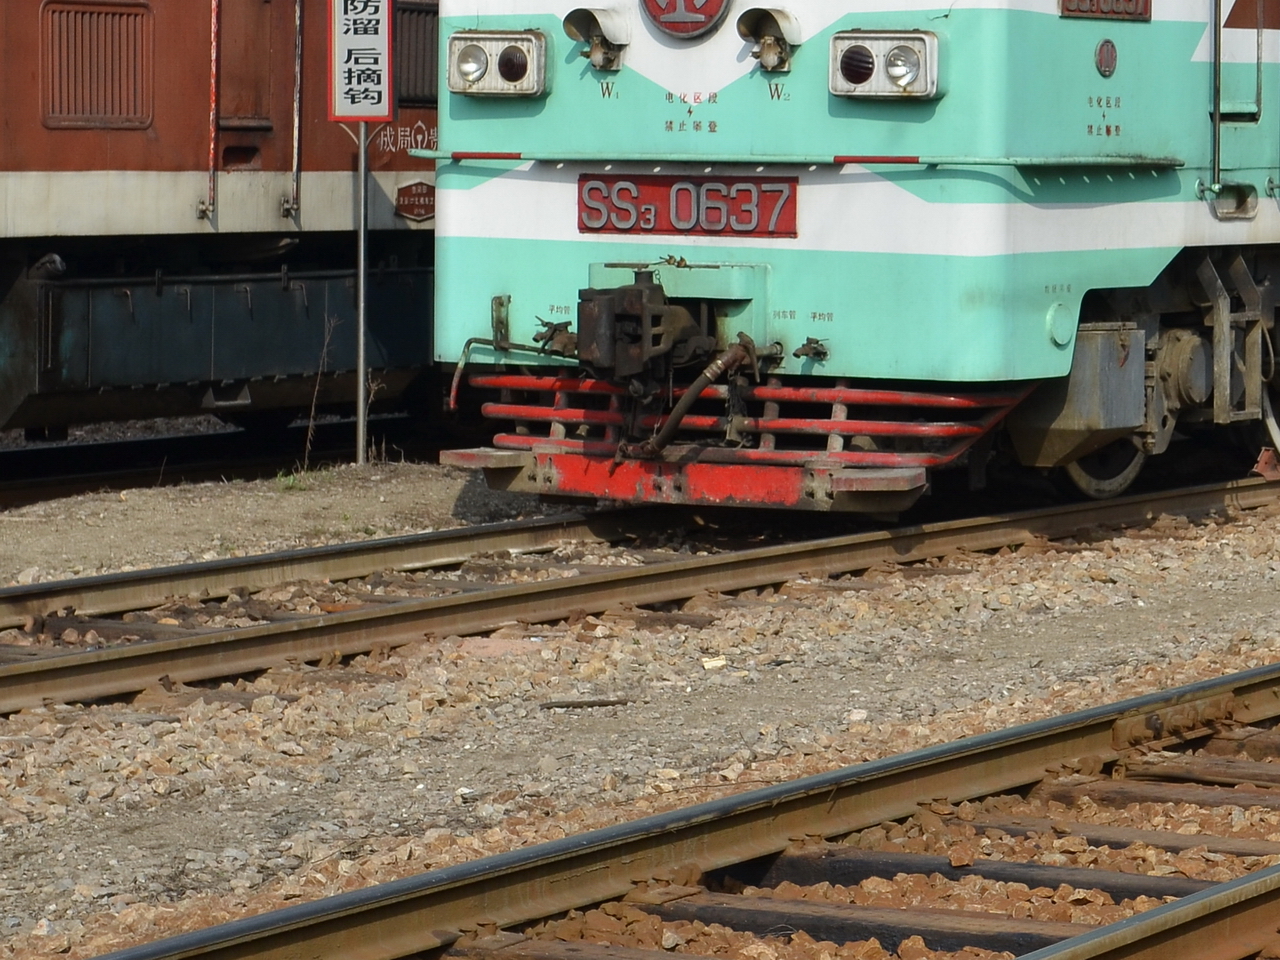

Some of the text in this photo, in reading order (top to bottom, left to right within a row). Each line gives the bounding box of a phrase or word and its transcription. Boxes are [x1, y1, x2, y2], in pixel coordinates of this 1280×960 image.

[343, 47, 383, 105] 后摘钩
[768, 83, 790, 101] W2
[665, 92, 718, 104] 电化区段
[669, 181, 790, 231] 0637
